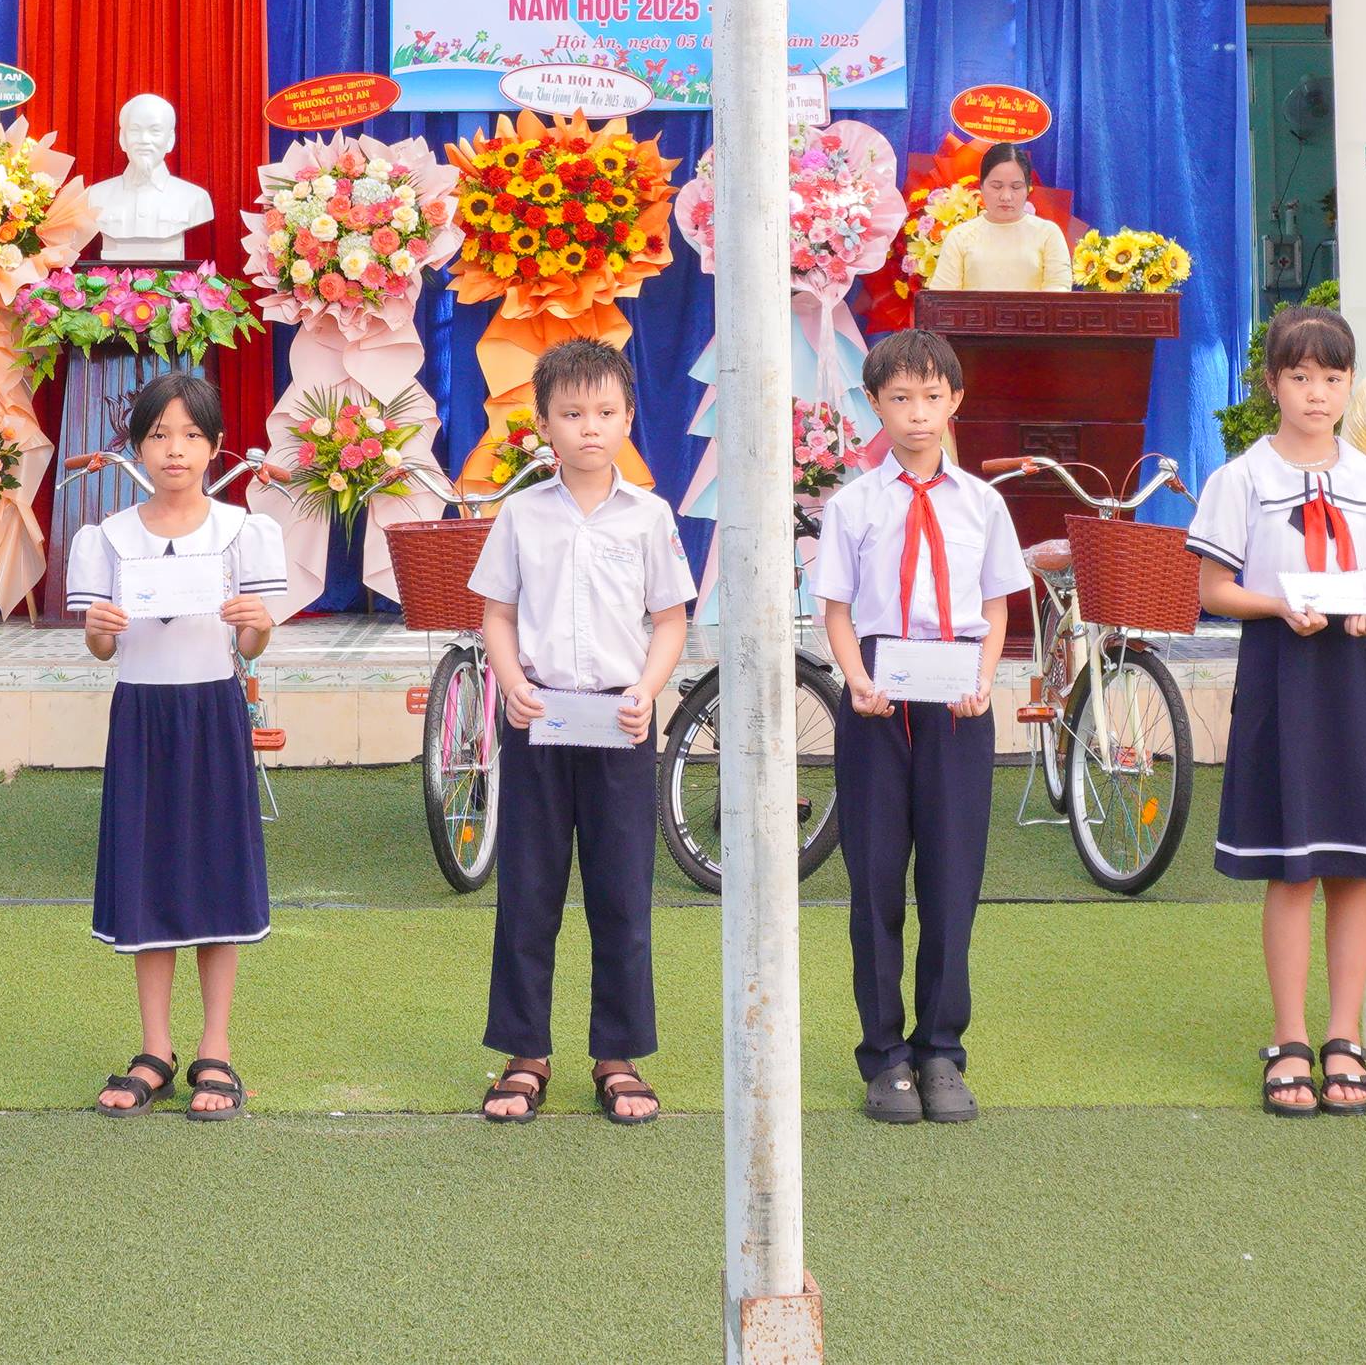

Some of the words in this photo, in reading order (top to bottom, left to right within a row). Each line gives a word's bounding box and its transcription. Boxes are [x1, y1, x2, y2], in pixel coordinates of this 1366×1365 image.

[555, 34, 586, 50] Hội
[593, 35, 621, 51] An,
[628, 35, 670, 51] ngày
[676, 35, 696, 49] 05
[787, 34, 813, 48] ăm
[820, 34, 860, 48] 2025
[3, 73, 23, 81] AN
[568, 74, 593, 87] HỘI
[596, 78, 616, 89] AN
[356, 90, 370, 100] AN
